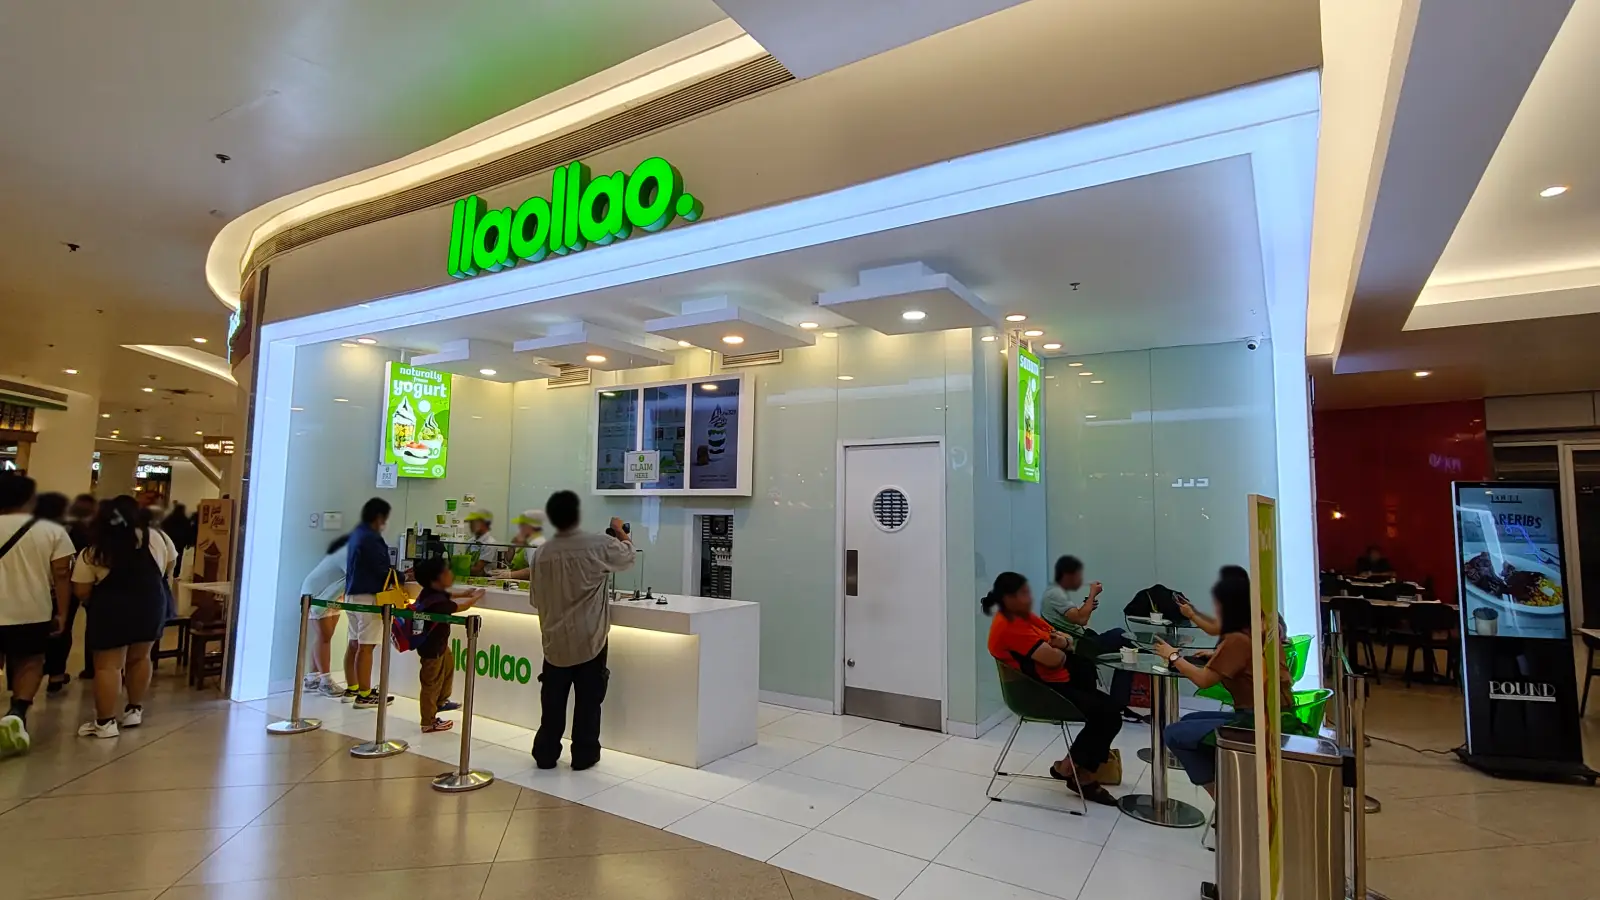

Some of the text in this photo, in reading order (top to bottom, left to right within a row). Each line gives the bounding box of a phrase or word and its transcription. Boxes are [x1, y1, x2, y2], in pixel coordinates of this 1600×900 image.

[399, 367, 443, 383] naturally
[393, 379, 447, 398] yogurt
[144, 464, 169, 474] Shabu
[630, 463, 653, 471] CLAIM
[1476, 513, 1543, 529] ARERIBS
[1489, 681, 1556, 697] POUND
